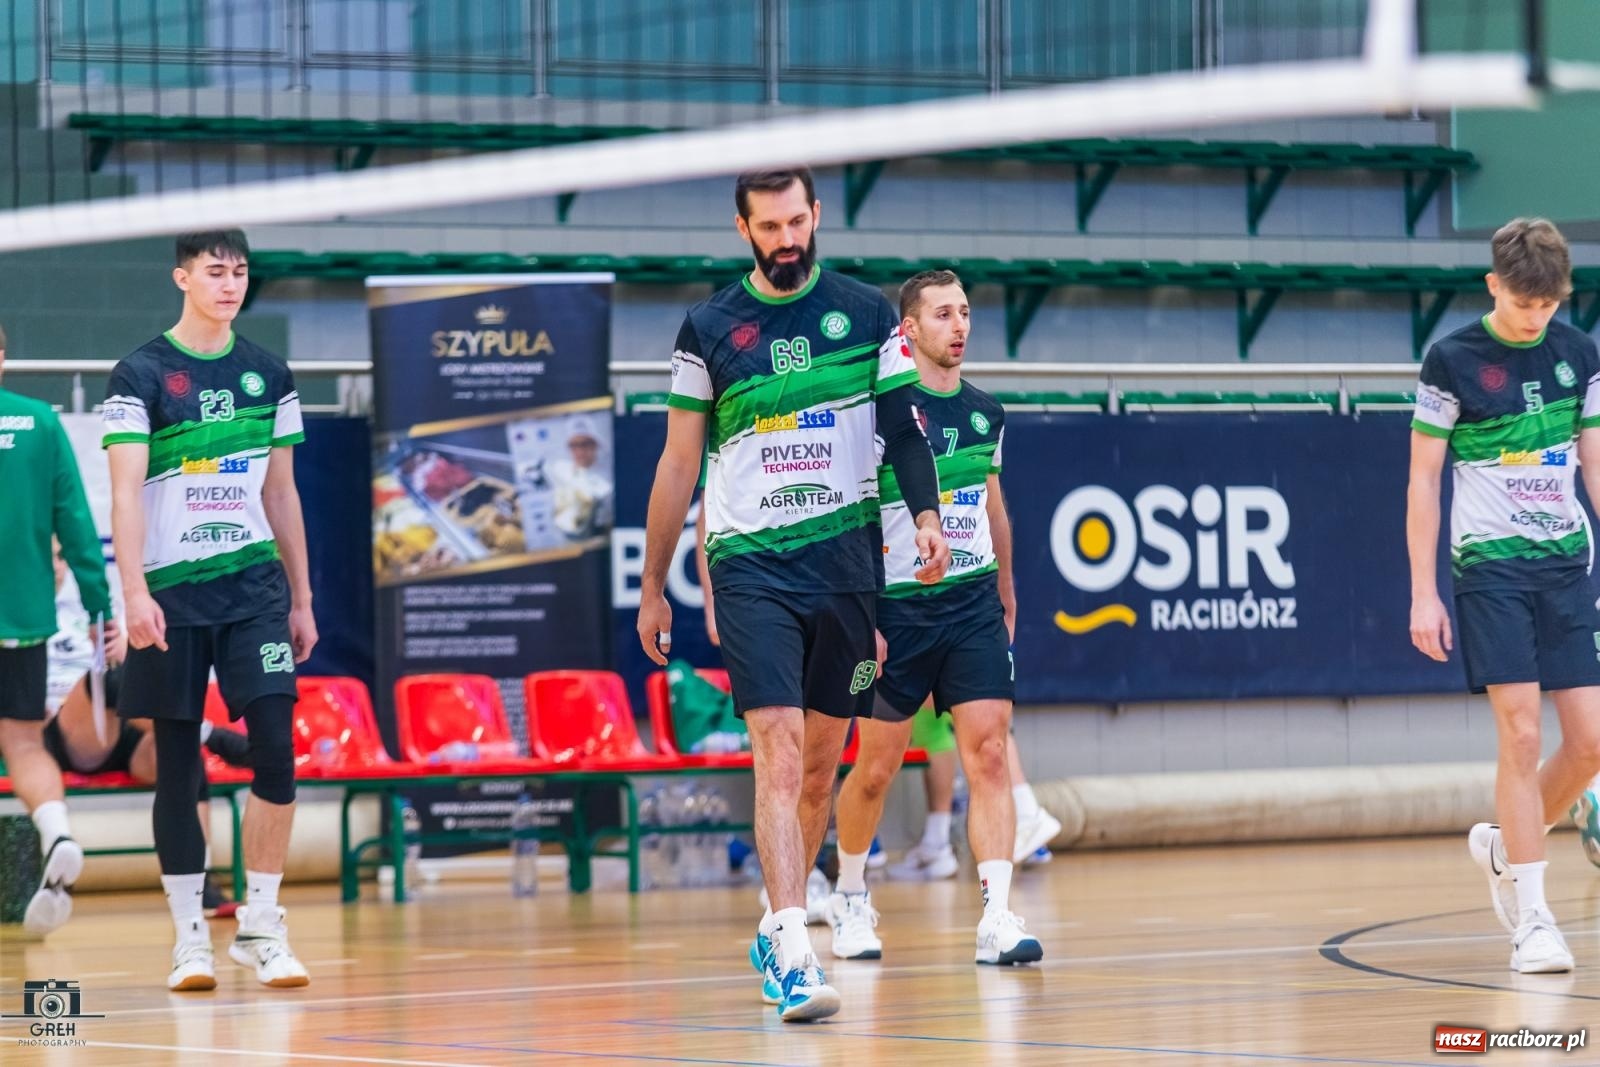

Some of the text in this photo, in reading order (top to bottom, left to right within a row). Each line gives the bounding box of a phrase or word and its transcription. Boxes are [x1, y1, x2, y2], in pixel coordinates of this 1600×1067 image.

[770, 336, 812, 375] 69
[199, 389, 235, 422] 23
[1522, 378, 1544, 415] 5
[761, 442, 832, 463] PIVEXIN
[943, 427, 959, 457] 7
[763, 460, 831, 474] TECHNOLOGY
[1150, 589, 1298, 630] RACIBÓRZ
[260, 642, 295, 673] 23
[849, 660, 878, 695] 69
